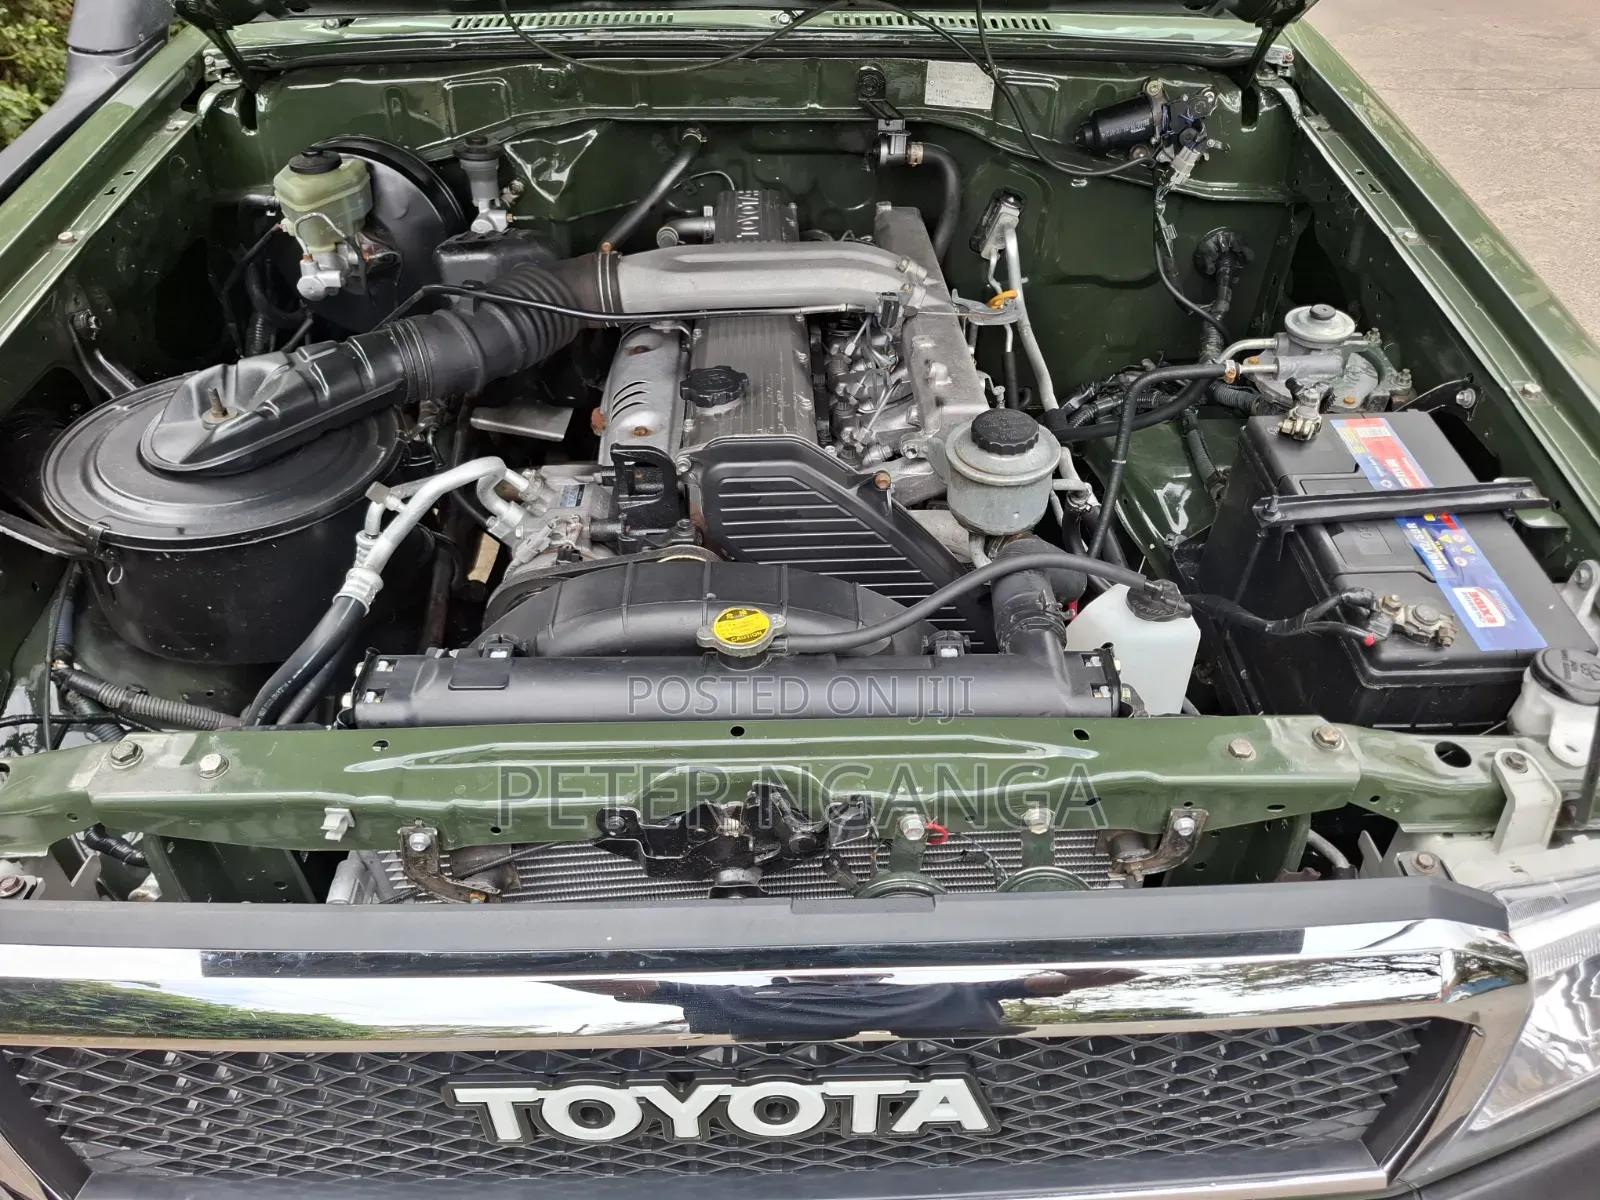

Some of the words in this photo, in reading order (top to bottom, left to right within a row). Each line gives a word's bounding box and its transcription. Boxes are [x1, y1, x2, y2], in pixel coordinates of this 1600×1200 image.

[1468, 591, 1499, 624] EXIDE
[731, 630, 762, 642] CAUTION
[453, 1078, 989, 1141] TOYOTA
